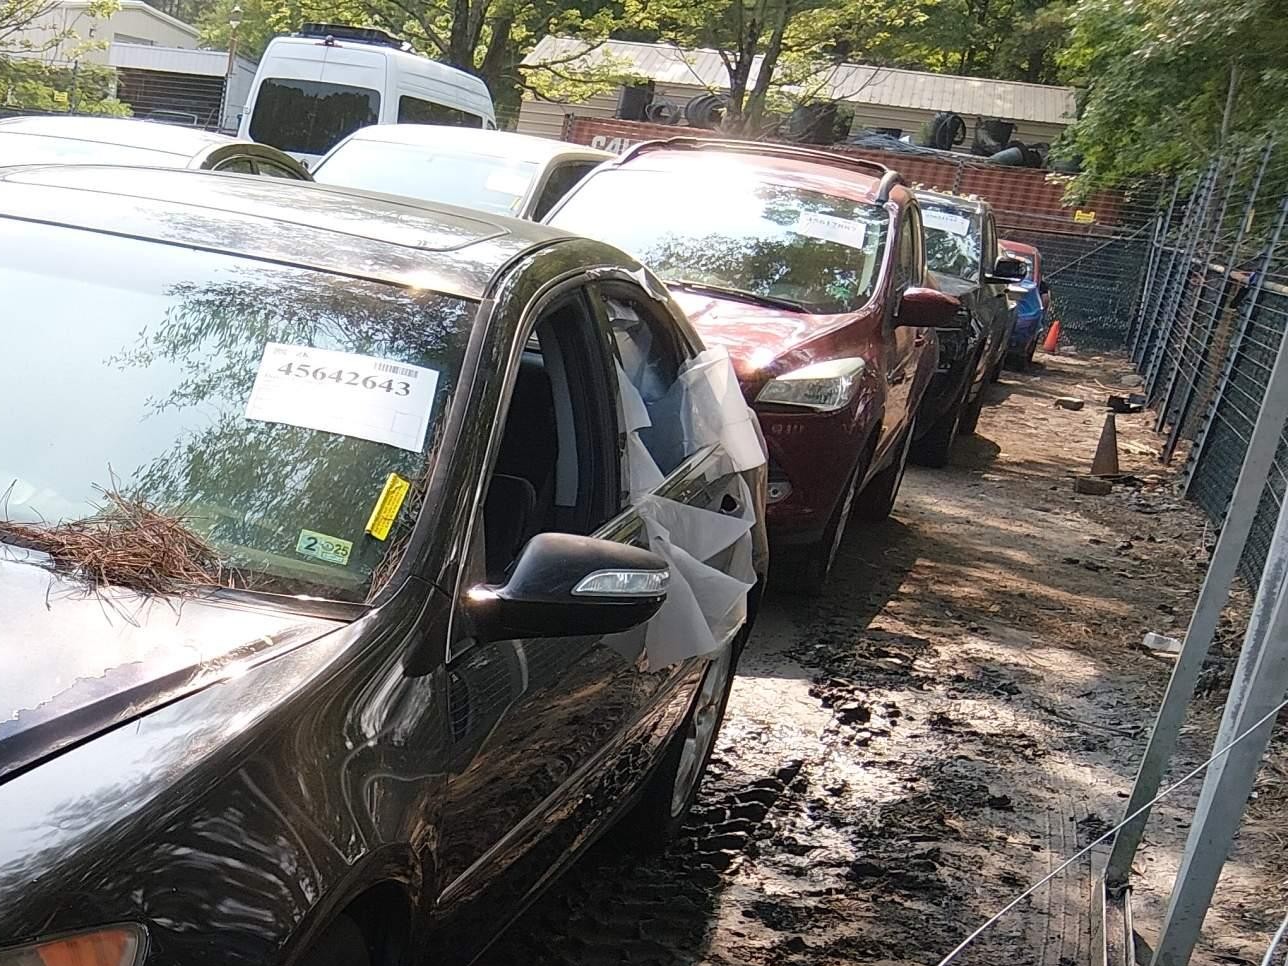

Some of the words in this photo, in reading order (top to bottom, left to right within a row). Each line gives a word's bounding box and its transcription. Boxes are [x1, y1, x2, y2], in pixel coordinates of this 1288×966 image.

[277, 361, 411, 397] 45642643
[304, 536, 318, 551] 2
[333, 543, 350, 556] 25
